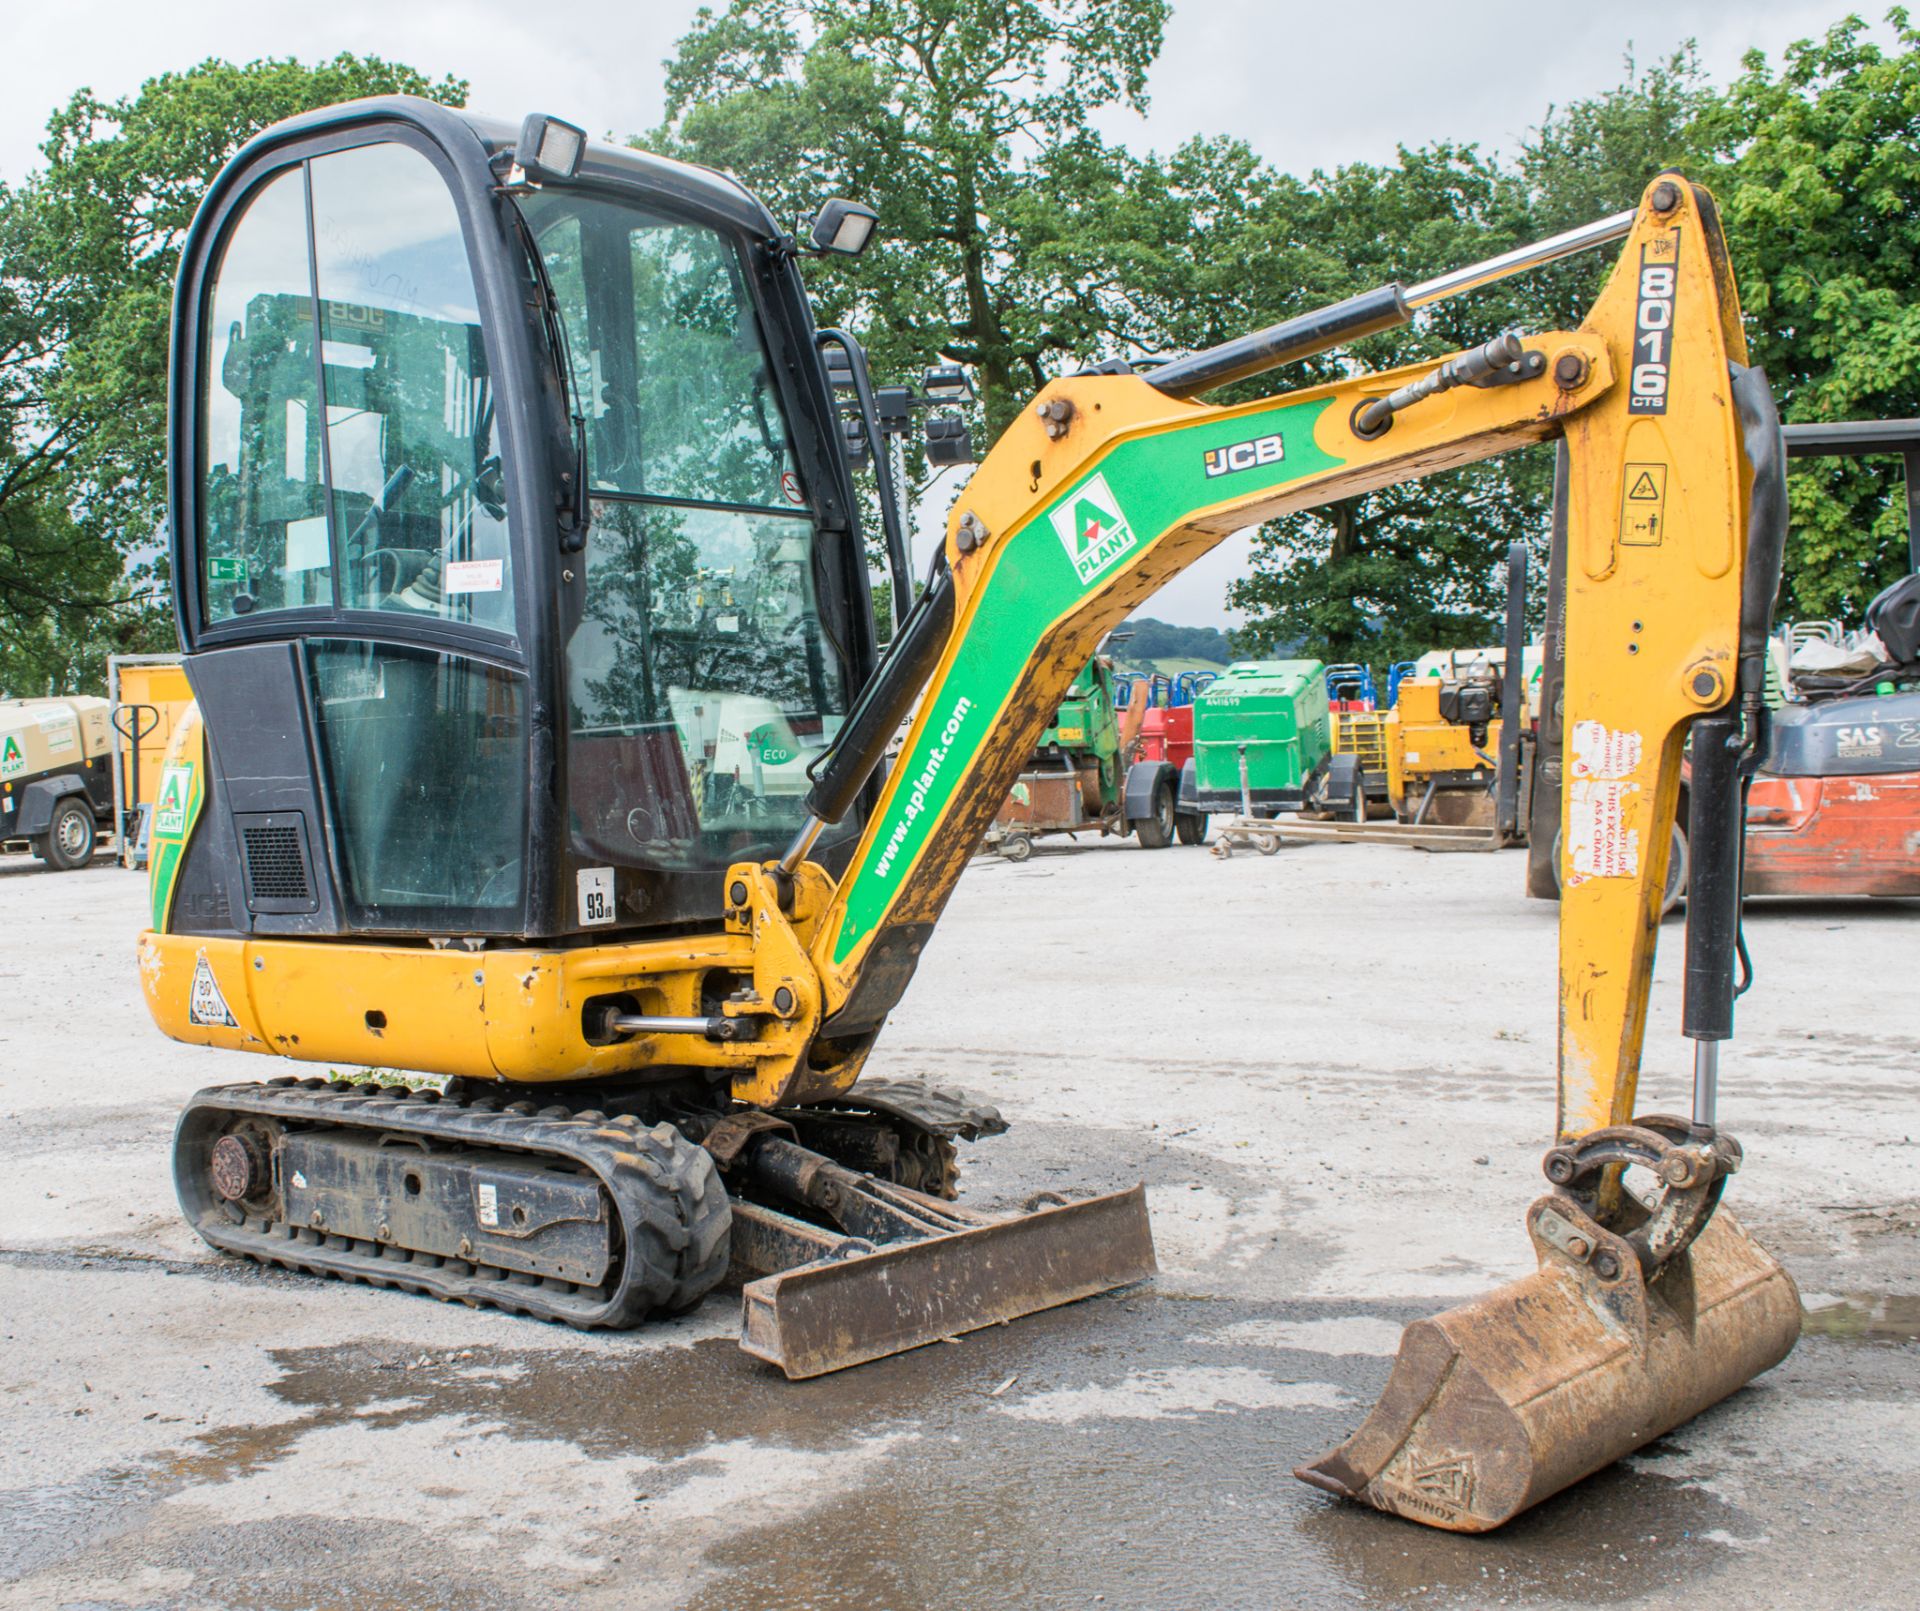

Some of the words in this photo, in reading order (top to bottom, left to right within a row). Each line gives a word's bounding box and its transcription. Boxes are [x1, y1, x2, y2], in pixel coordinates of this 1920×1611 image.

[1632, 267, 1675, 397] 8016
[1631, 396, 1664, 407] CTS
[1206, 435, 1284, 476] JCB
[1074, 498, 1119, 556] A
[1078, 526, 1131, 578] PLANT
[1836, 727, 1881, 747] SAS
[2, 761, 24, 773] PLANT
[763, 749, 787, 761] ECO
[874, 696, 971, 878] www.aplant.com
[1607, 785, 1617, 812] THIS
[1594, 800, 1604, 815] AS
[1594, 817, 1602, 826] A
[1593, 829, 1602, 870] CRANE
[587, 892, 604, 920] 93
[1398, 1491, 1456, 1524] RHINOX
